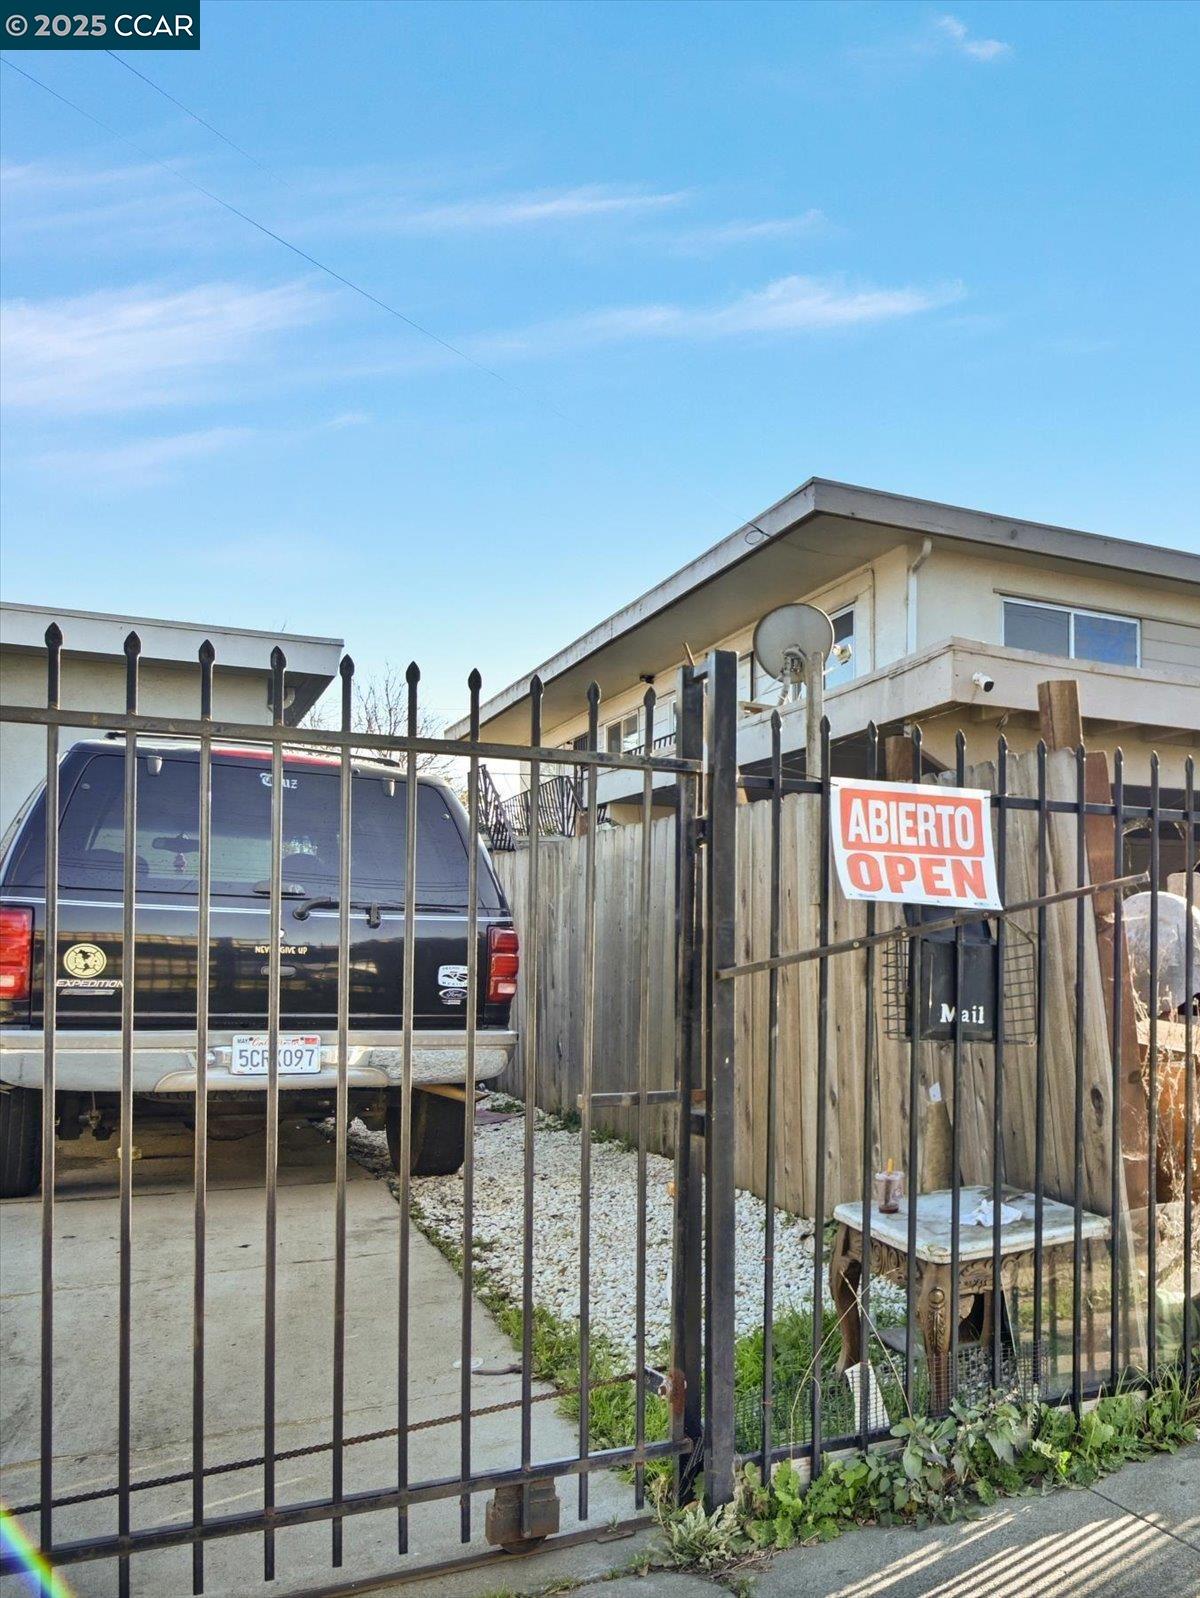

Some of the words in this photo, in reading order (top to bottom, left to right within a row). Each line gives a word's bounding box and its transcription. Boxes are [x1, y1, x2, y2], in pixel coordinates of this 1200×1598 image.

[847, 798, 975, 850] ABIERTO
[846, 852, 988, 899] OPEN
[297, 946, 308, 955] UP
[56, 979, 124, 988] EXPEDITION
[446, 989, 463, 998] Ford
[939, 1003, 985, 1025] Mail
